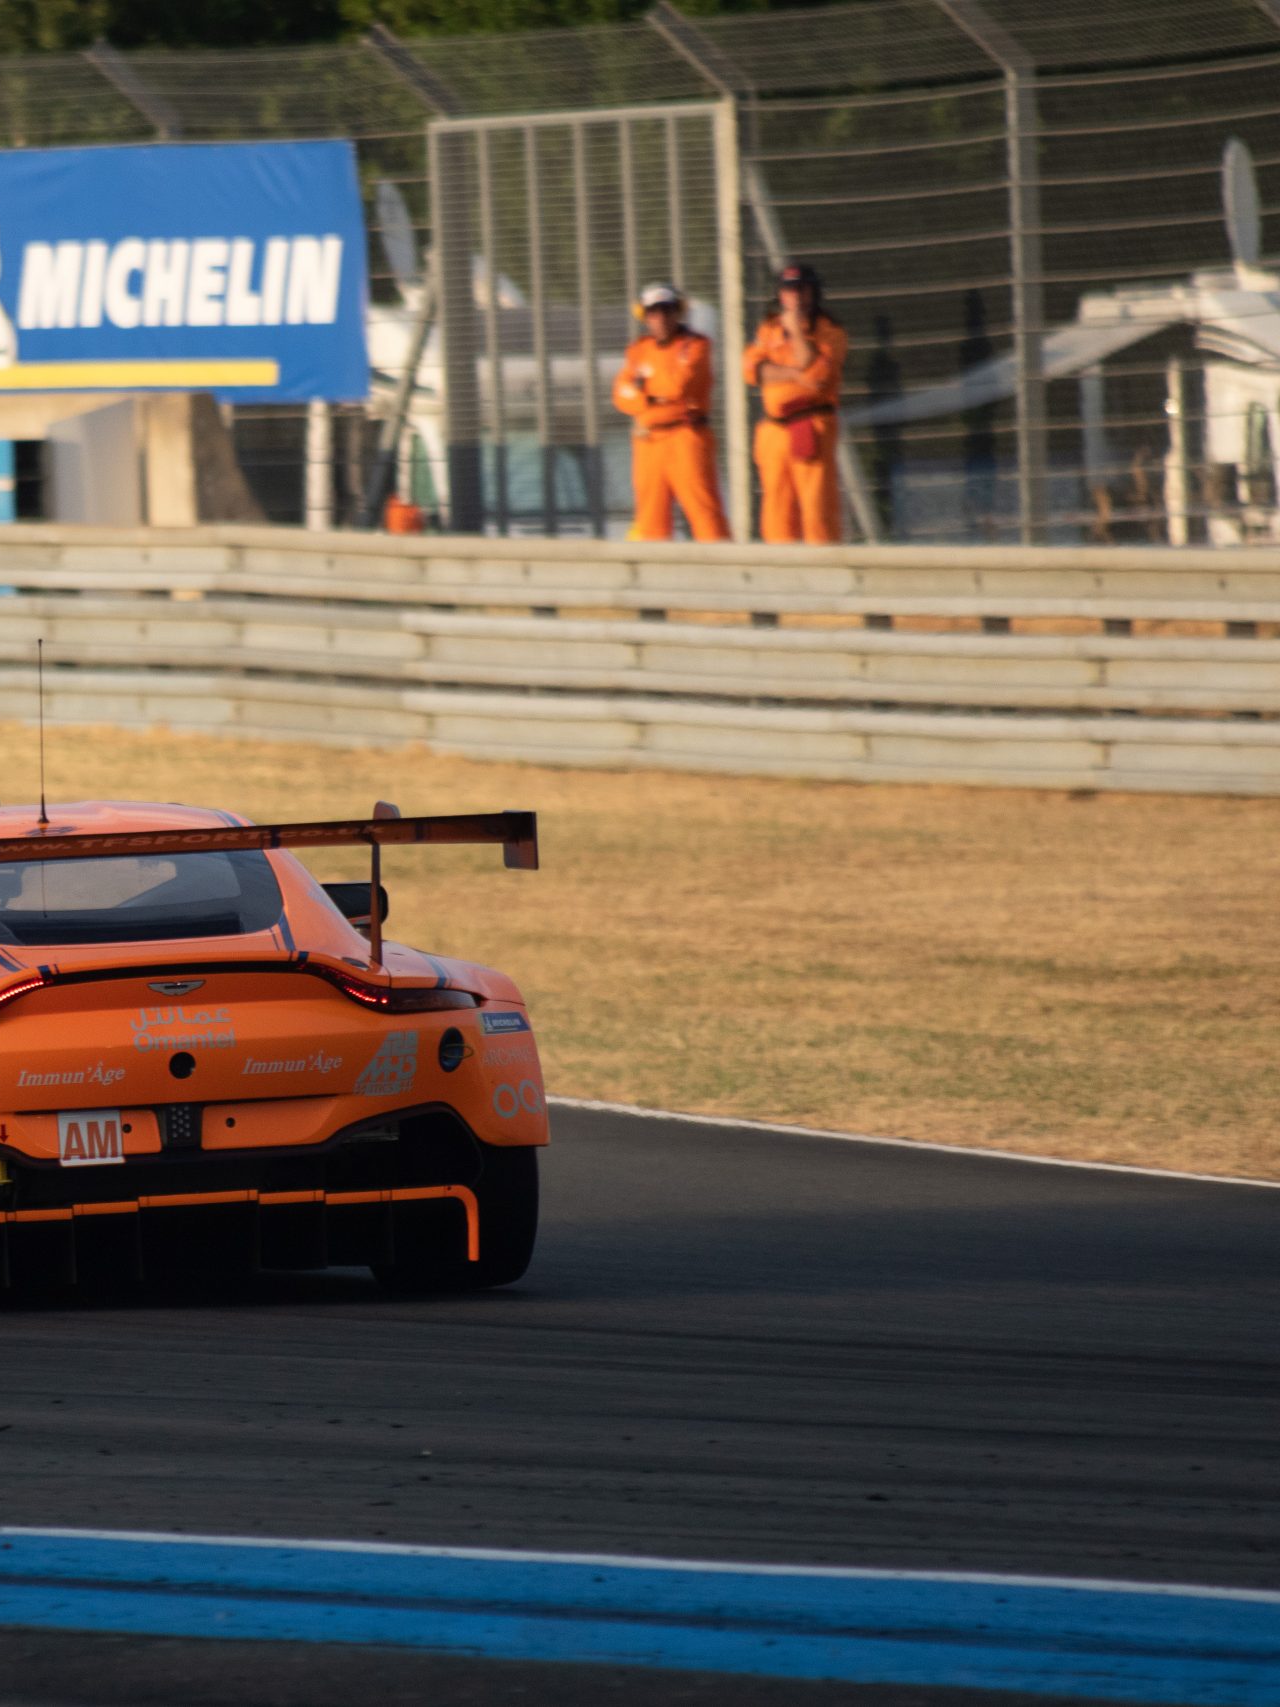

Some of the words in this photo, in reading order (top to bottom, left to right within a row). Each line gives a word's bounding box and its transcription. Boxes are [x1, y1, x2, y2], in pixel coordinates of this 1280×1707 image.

[16, 234, 344, 331] MICHELIN
[133, 1028, 237, 1053] Omantel
[493, 1079, 545, 1119] OQ
[63, 1120, 119, 1161] AM
